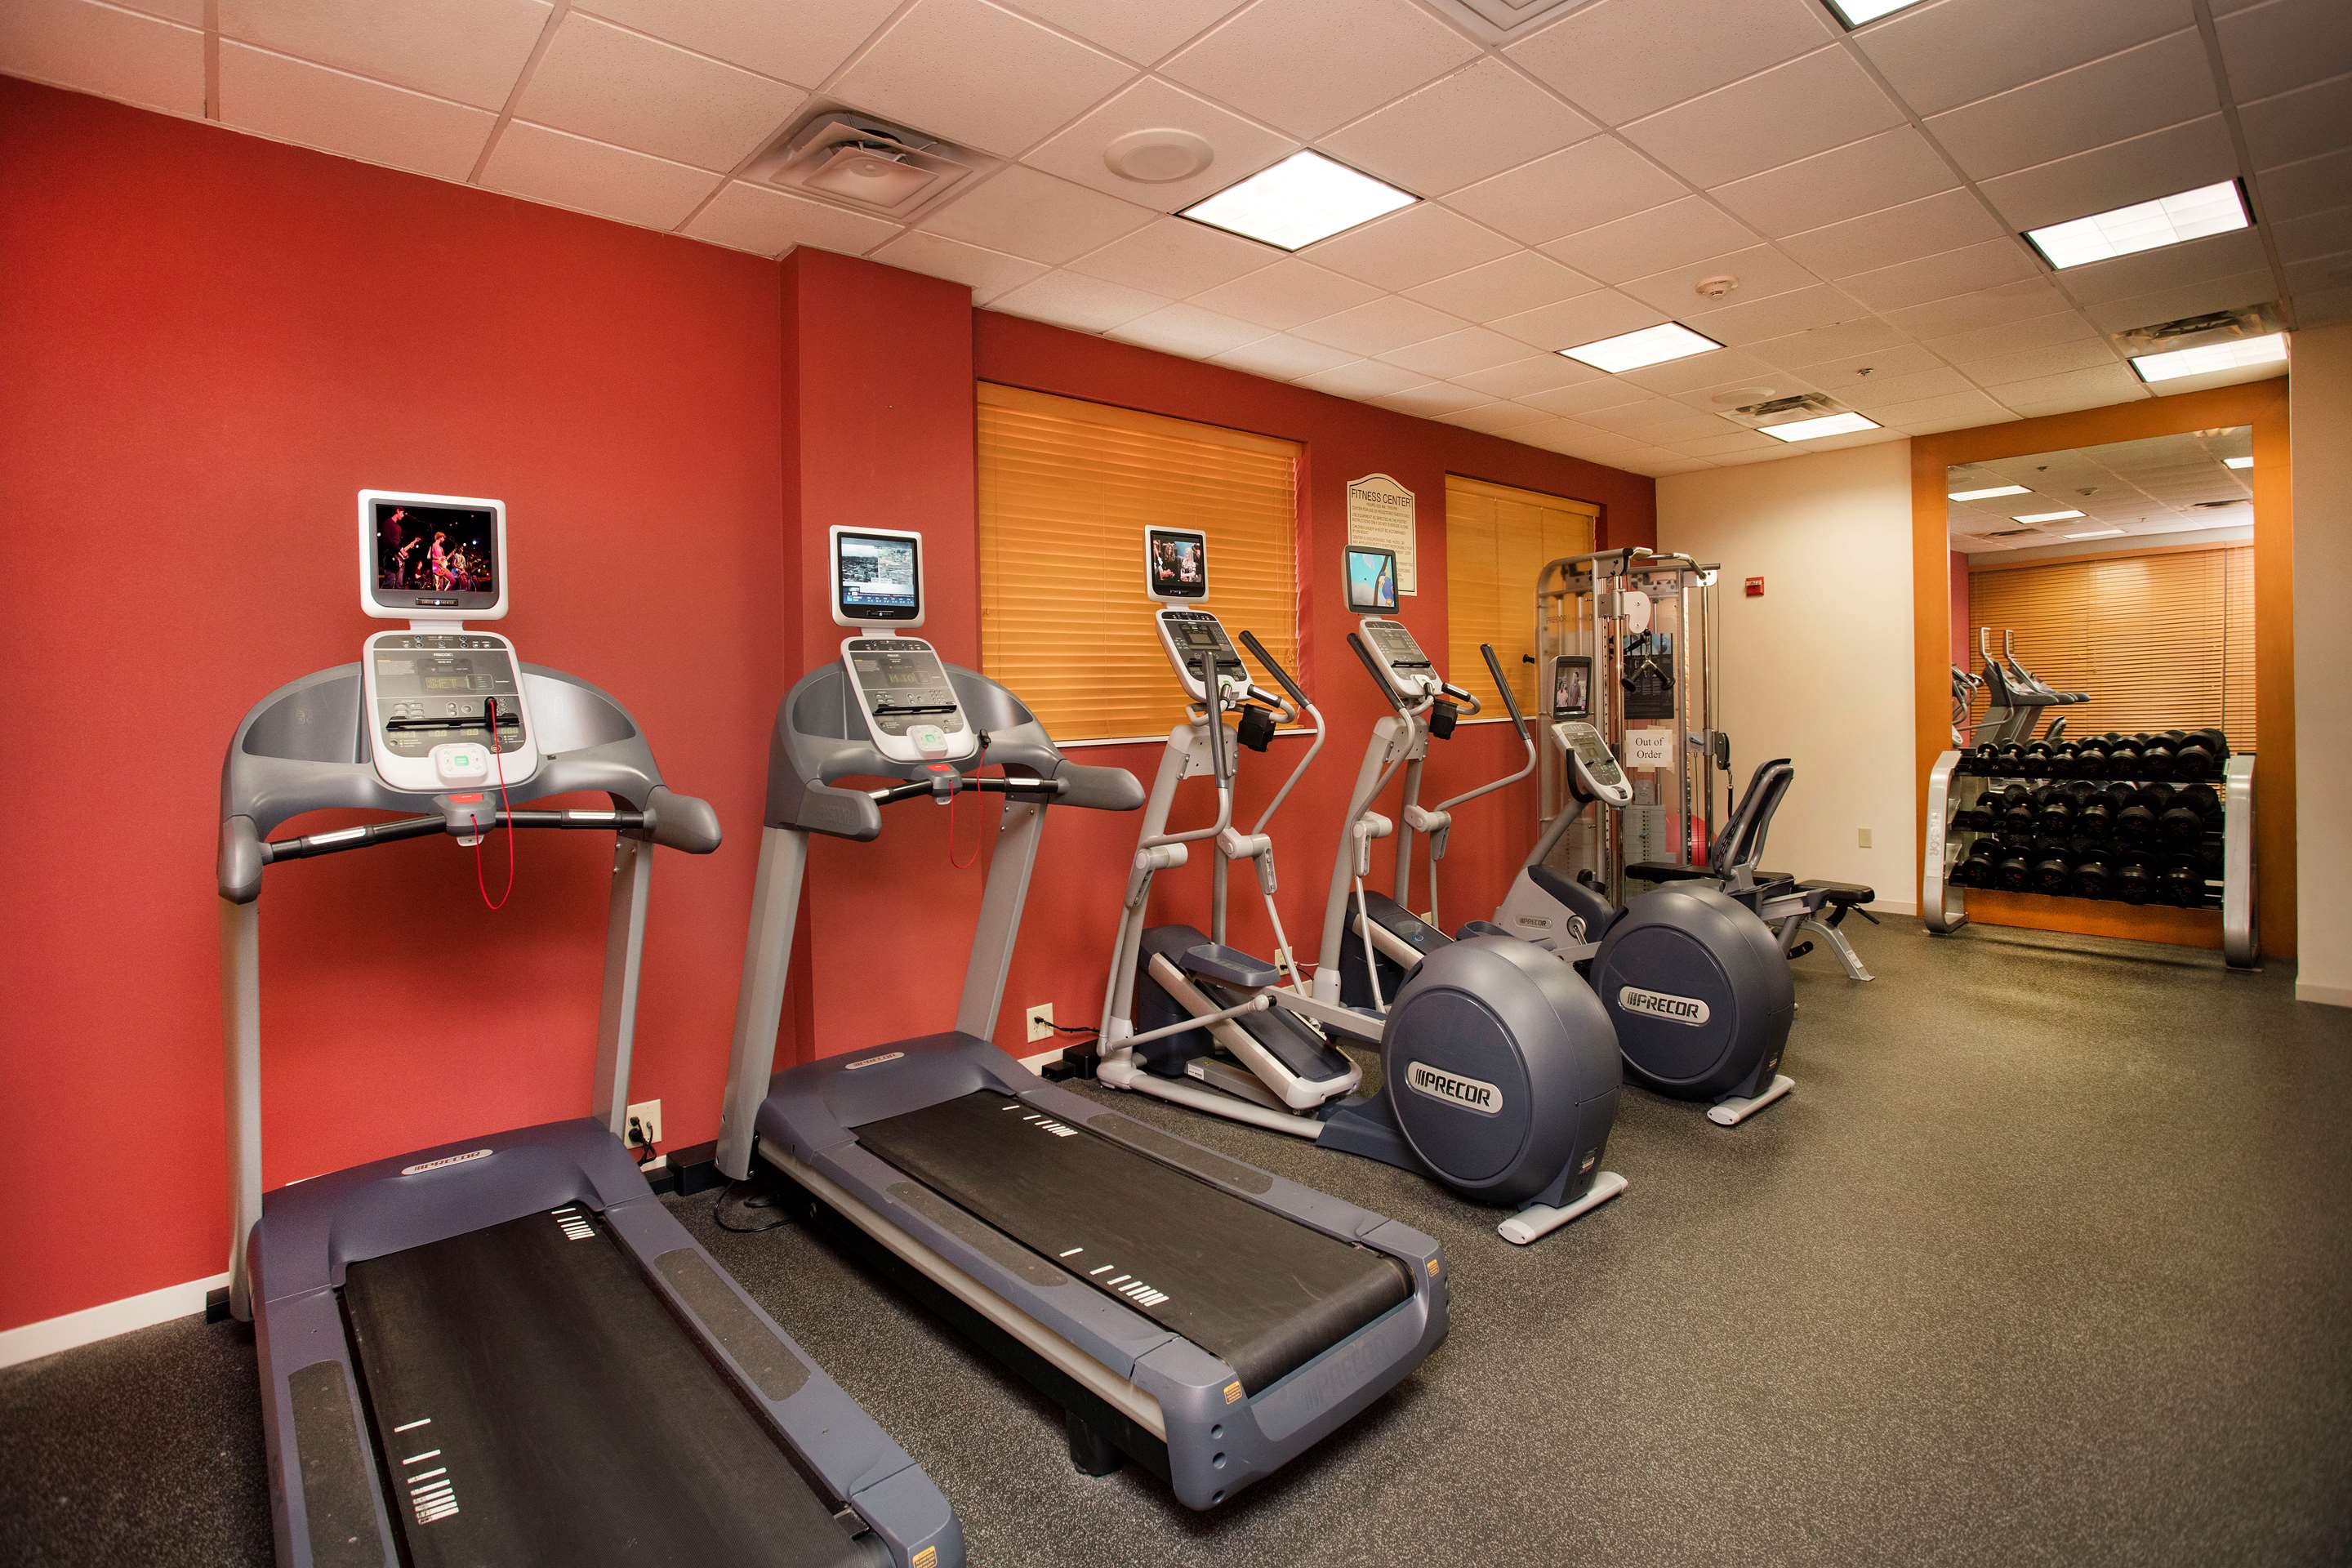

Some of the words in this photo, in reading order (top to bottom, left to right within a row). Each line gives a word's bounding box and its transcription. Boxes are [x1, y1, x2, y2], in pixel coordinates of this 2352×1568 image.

[1352, 488, 1381, 503] FITNESS
[1383, 494, 1411, 507] CENTER
[1635, 737, 1651, 746] Out
[1654, 737, 1664, 746] of
[1637, 750, 1662, 759] Order
[1637, 994, 1699, 1018] PRECOR
[1424, 1072, 1491, 1107] PRECOR
